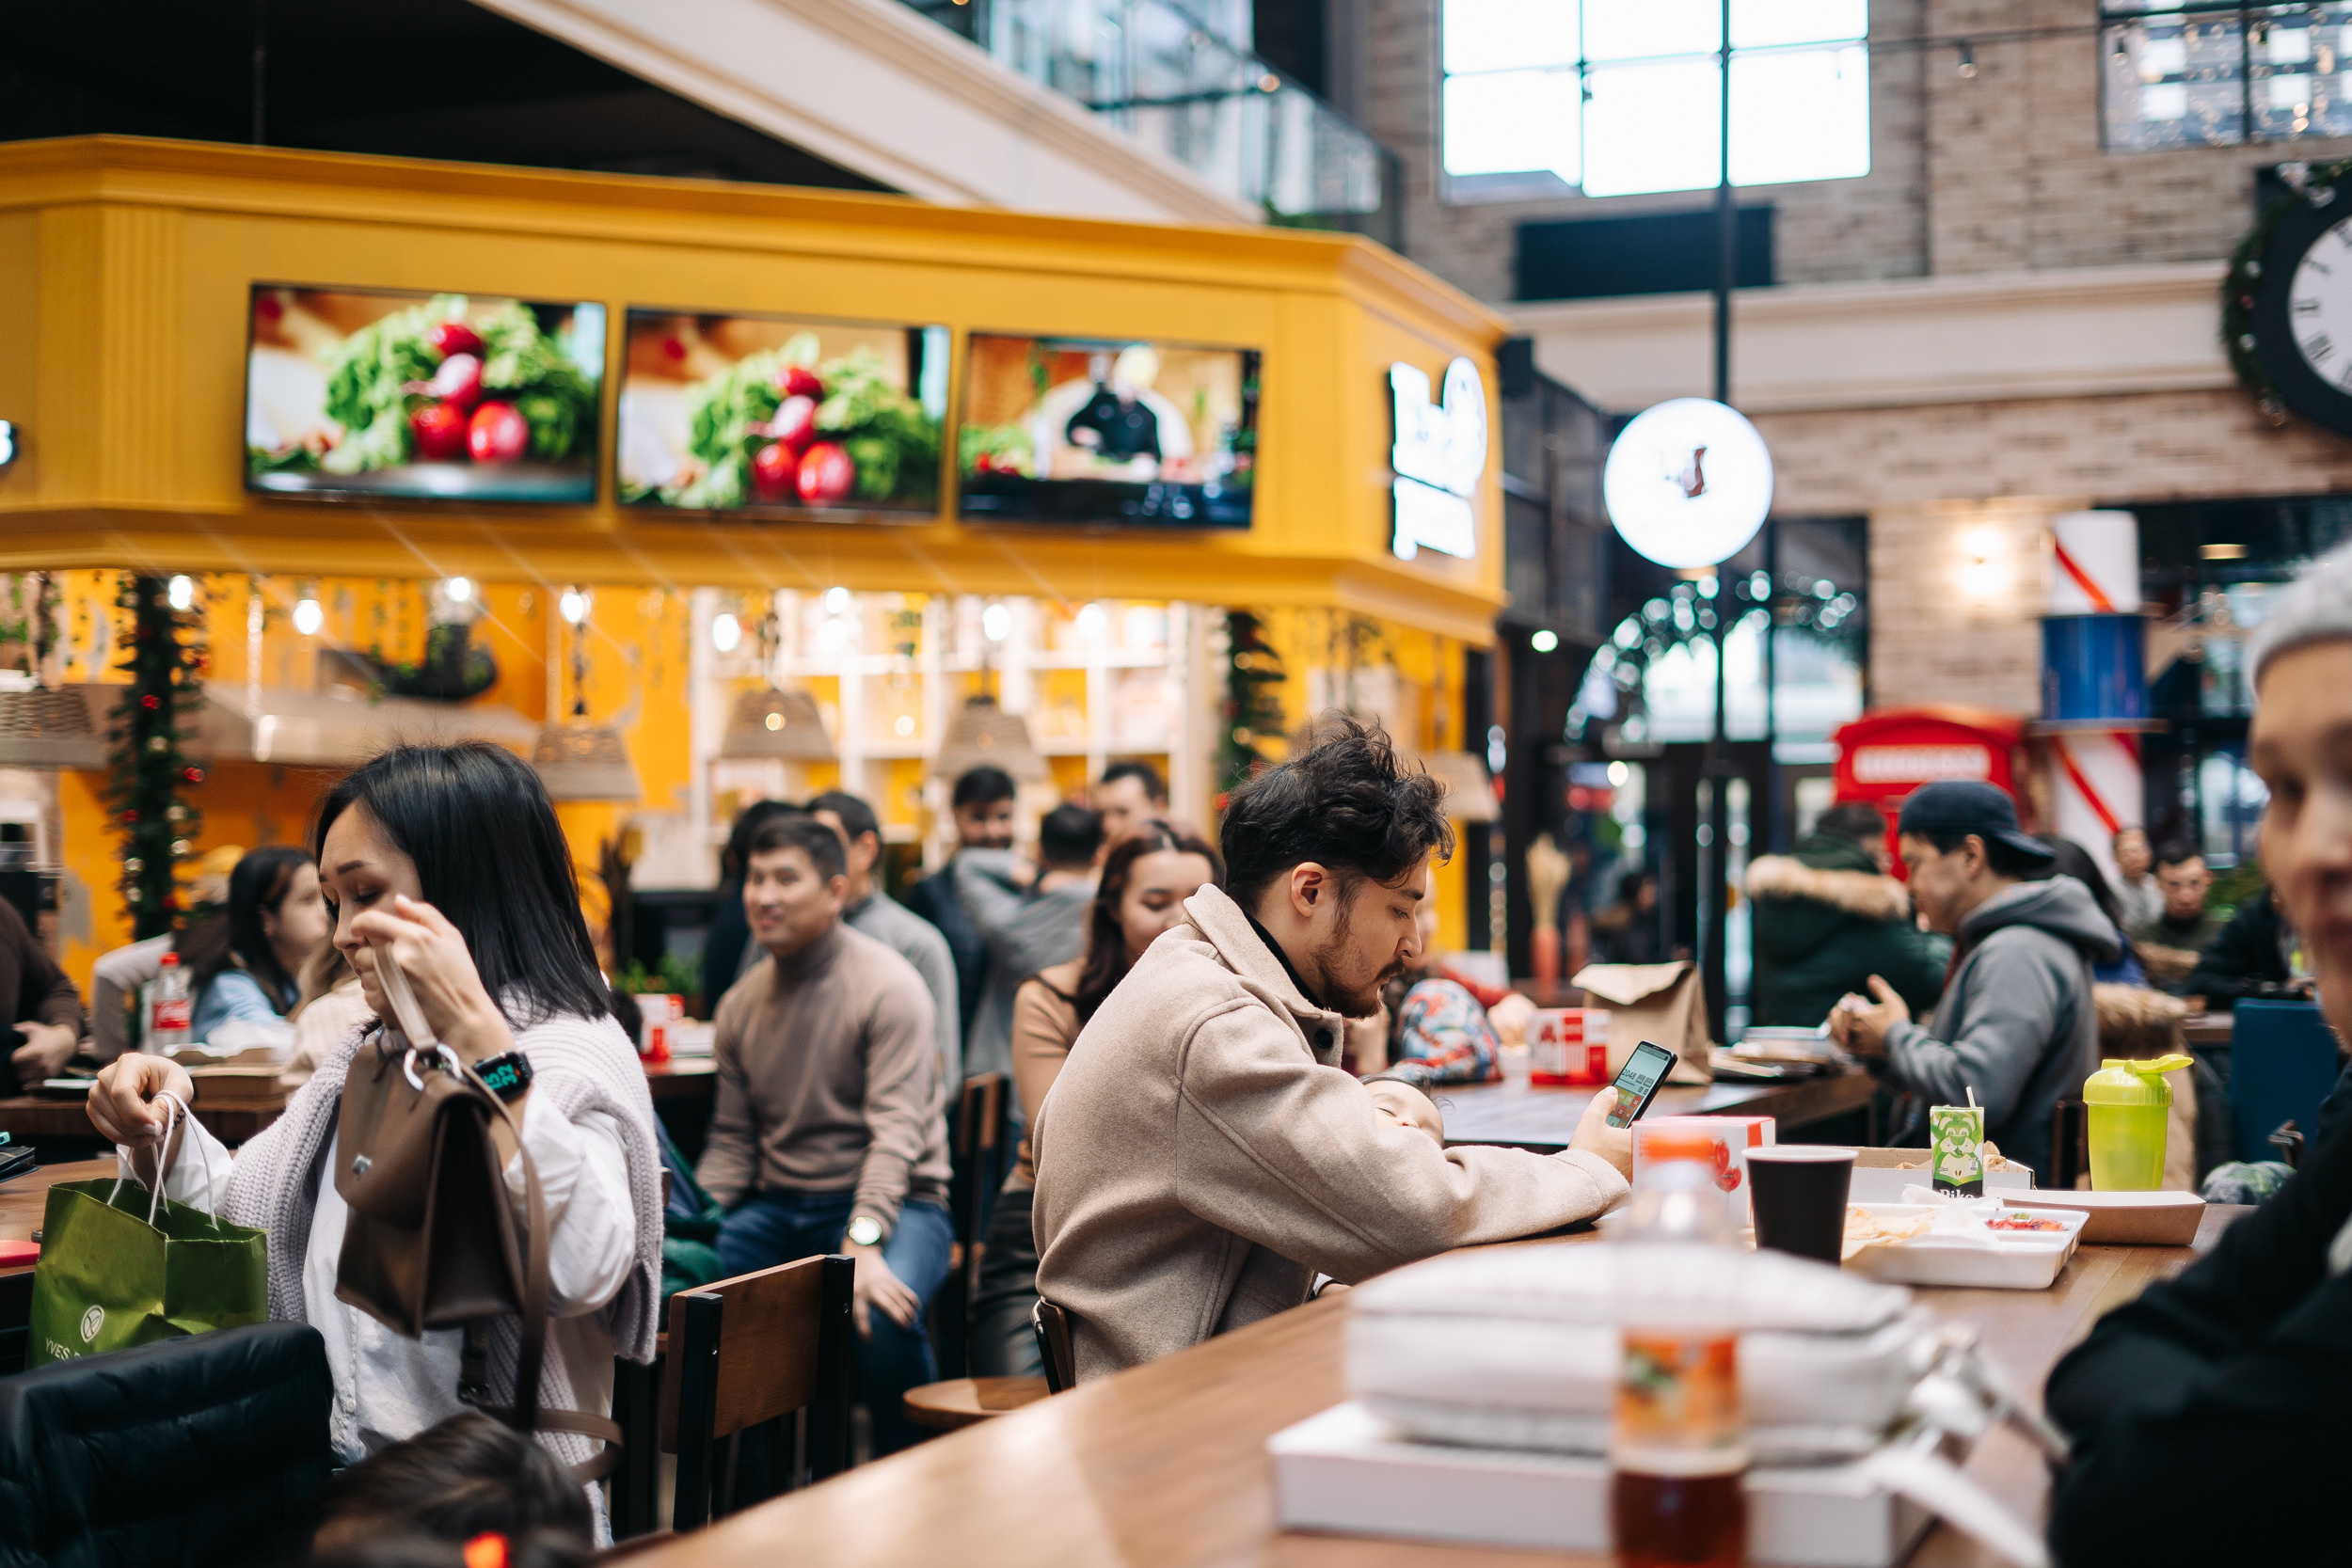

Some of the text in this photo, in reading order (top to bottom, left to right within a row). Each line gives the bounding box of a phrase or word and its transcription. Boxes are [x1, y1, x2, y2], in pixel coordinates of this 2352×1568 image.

[497, 1064, 517, 1085] 32
[1622, 1069, 1636, 1079] 2048
[46, 1338, 70, 1360] YVES
